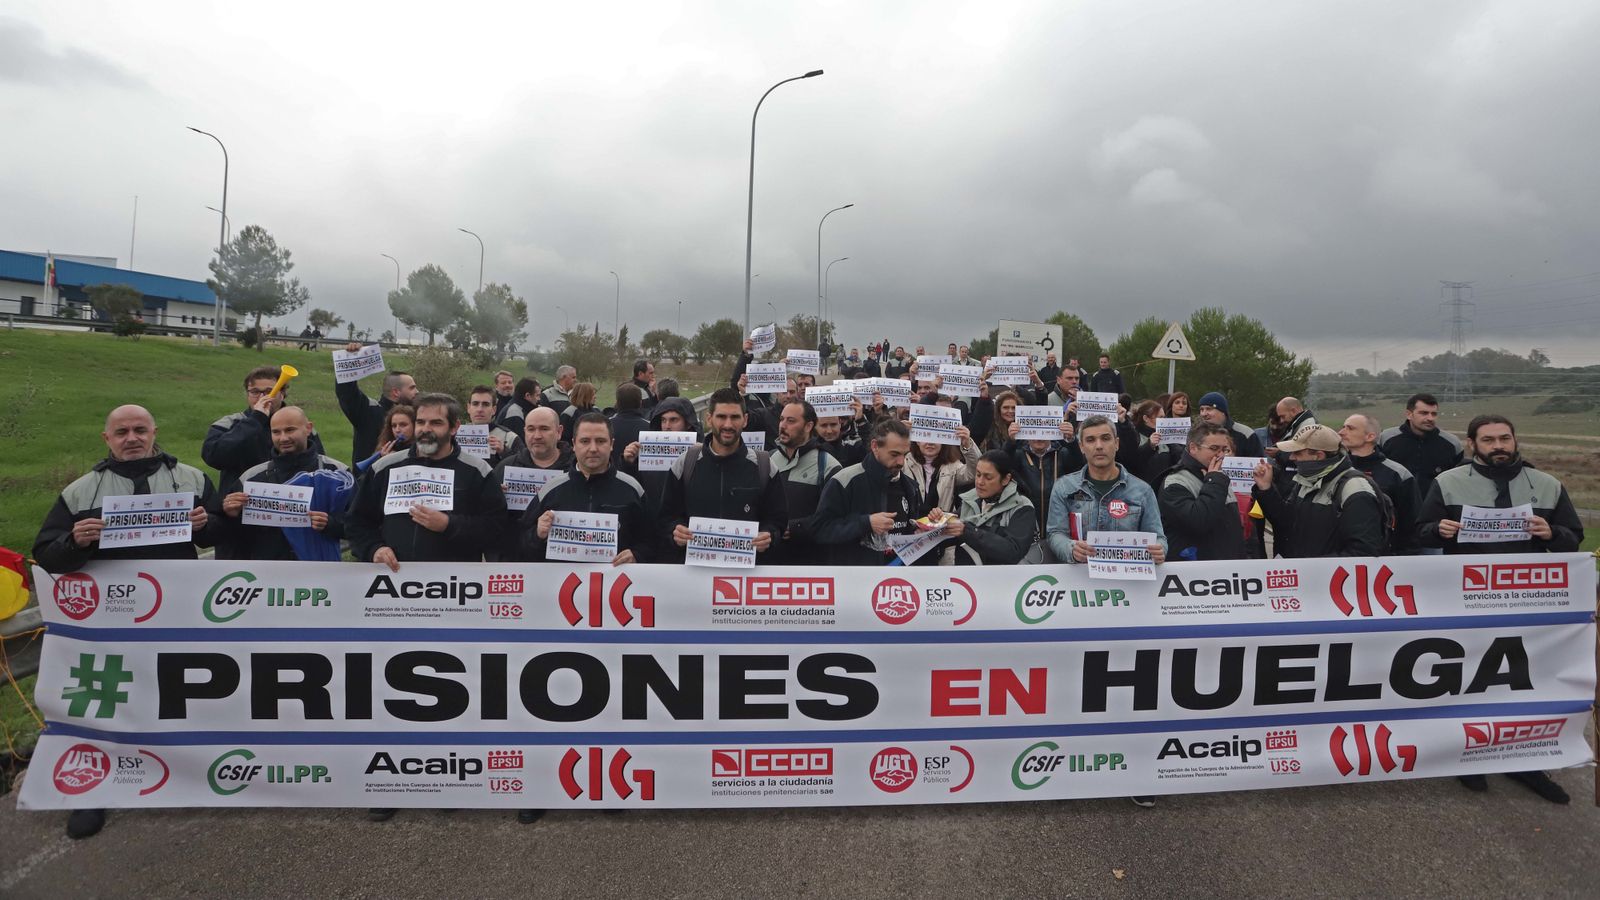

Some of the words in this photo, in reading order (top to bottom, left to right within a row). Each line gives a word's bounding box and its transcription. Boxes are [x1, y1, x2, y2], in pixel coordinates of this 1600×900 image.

[1270, 577, 1295, 587] EPSU
[1496, 567, 1564, 585] CCOO
[58, 580, 94, 601] UGT
[215, 587, 263, 605] CSIF
[364, 575, 483, 606] Acaip
[491, 581, 521, 593] EPSU
[752, 582, 830, 600] CCOO
[877, 585, 913, 602] UGT
[1158, 573, 1263, 601] Acaip
[1329, 564, 1418, 617] CIG
[1463, 591, 1502, 600] servicios
[1521, 590, 1569, 598] ciudadanía
[558, 572, 656, 628] CIG
[1025, 590, 1066, 607] CSIF
[712, 608, 757, 616] servicios
[780, 607, 835, 616] ciudadanía
[61, 650, 880, 722] #PRISIONES
[930, 667, 1048, 717] EN
[1081, 636, 1534, 713] HUELGA
[1498, 723, 1559, 742] CCOO
[1156, 735, 1262, 762] Acaip
[1268, 737, 1294, 748] EPSU
[1329, 723, 1417, 776] CIG
[62, 750, 105, 771] UGT
[364, 752, 483, 781] Acaip
[491, 757, 520, 768] EPSU
[751, 753, 828, 771] CCOO
[875, 754, 912, 771] UGT
[1022, 756, 1066, 773] CSIF
[217, 765, 263, 781] CSIF
[558, 747, 655, 800] CIG
[712, 778, 756, 787] servicios
[779, 777, 833, 786] ciudadanía
